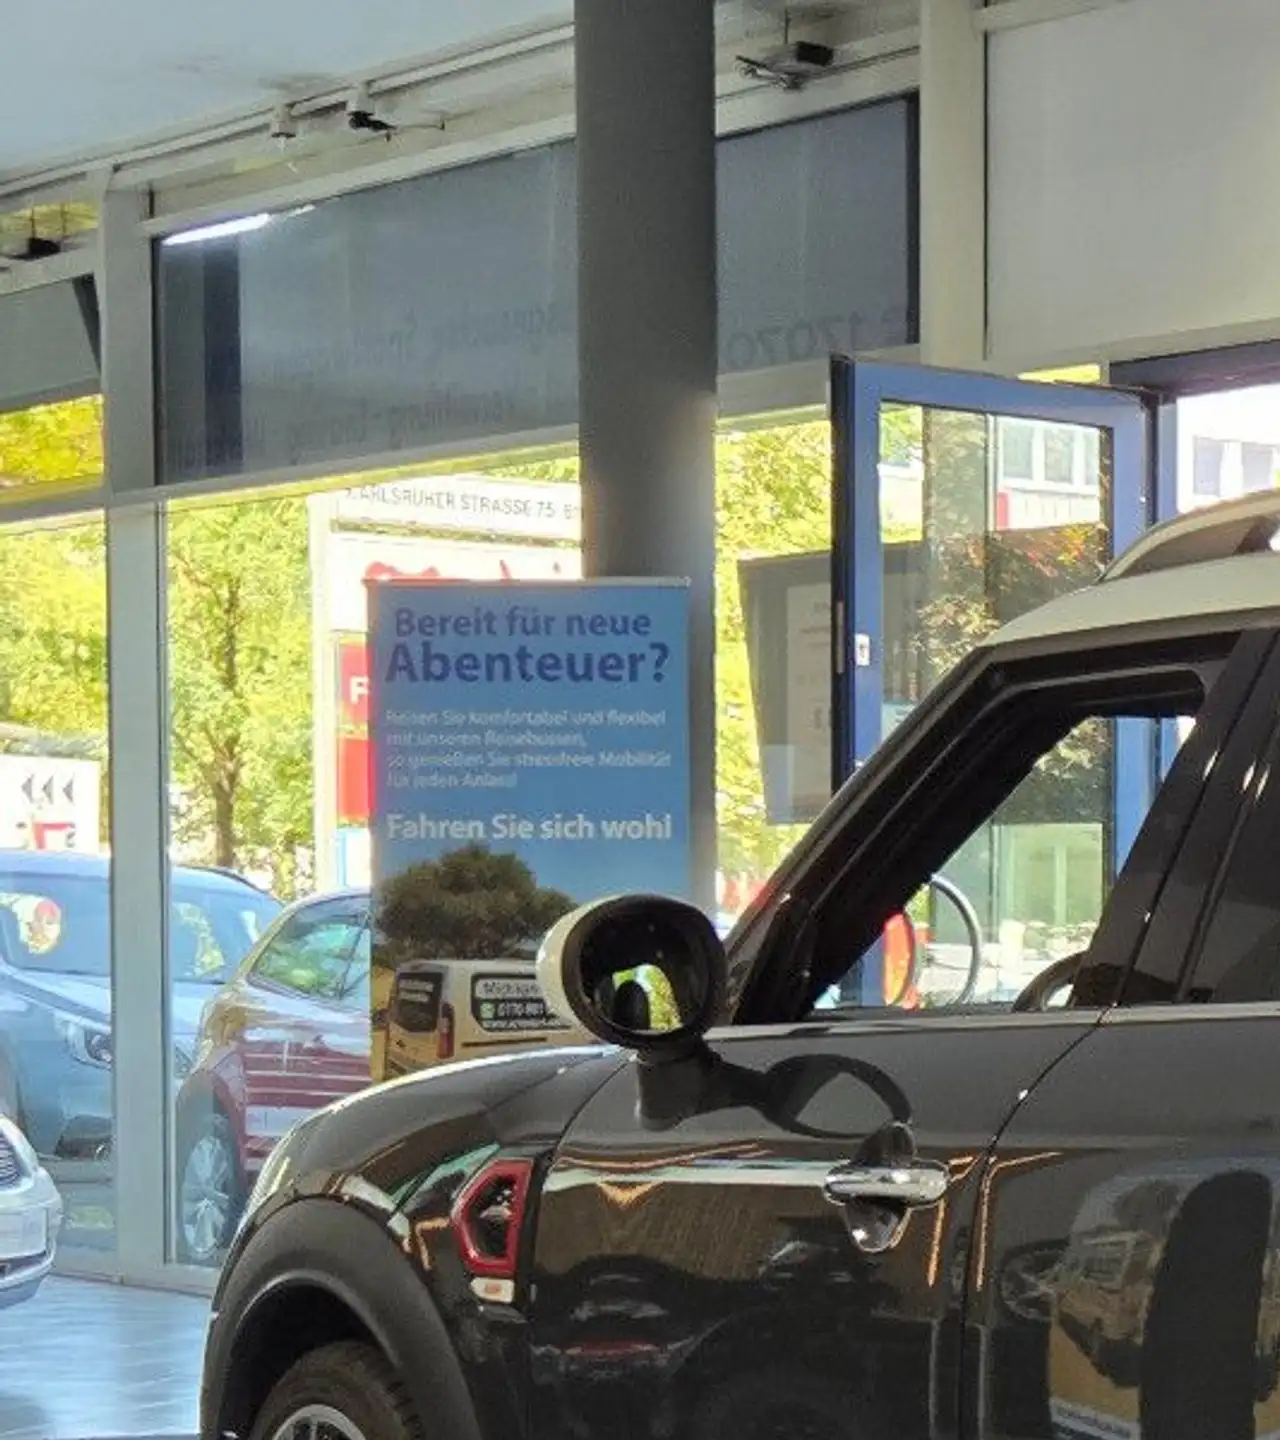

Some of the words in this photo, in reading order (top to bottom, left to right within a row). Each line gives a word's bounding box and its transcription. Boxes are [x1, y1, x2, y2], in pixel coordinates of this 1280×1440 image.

[460, 496, 532, 518] STRASSE
[394, 606, 498, 638] Bereit
[506, 605, 556, 638] für
[565, 613, 653, 638] neue
[384, 640, 672, 684] Abenteuer?
[386, 812, 486, 839] Fahren
[491, 813, 534, 839] Sie
[540, 812, 595, 839] sich
